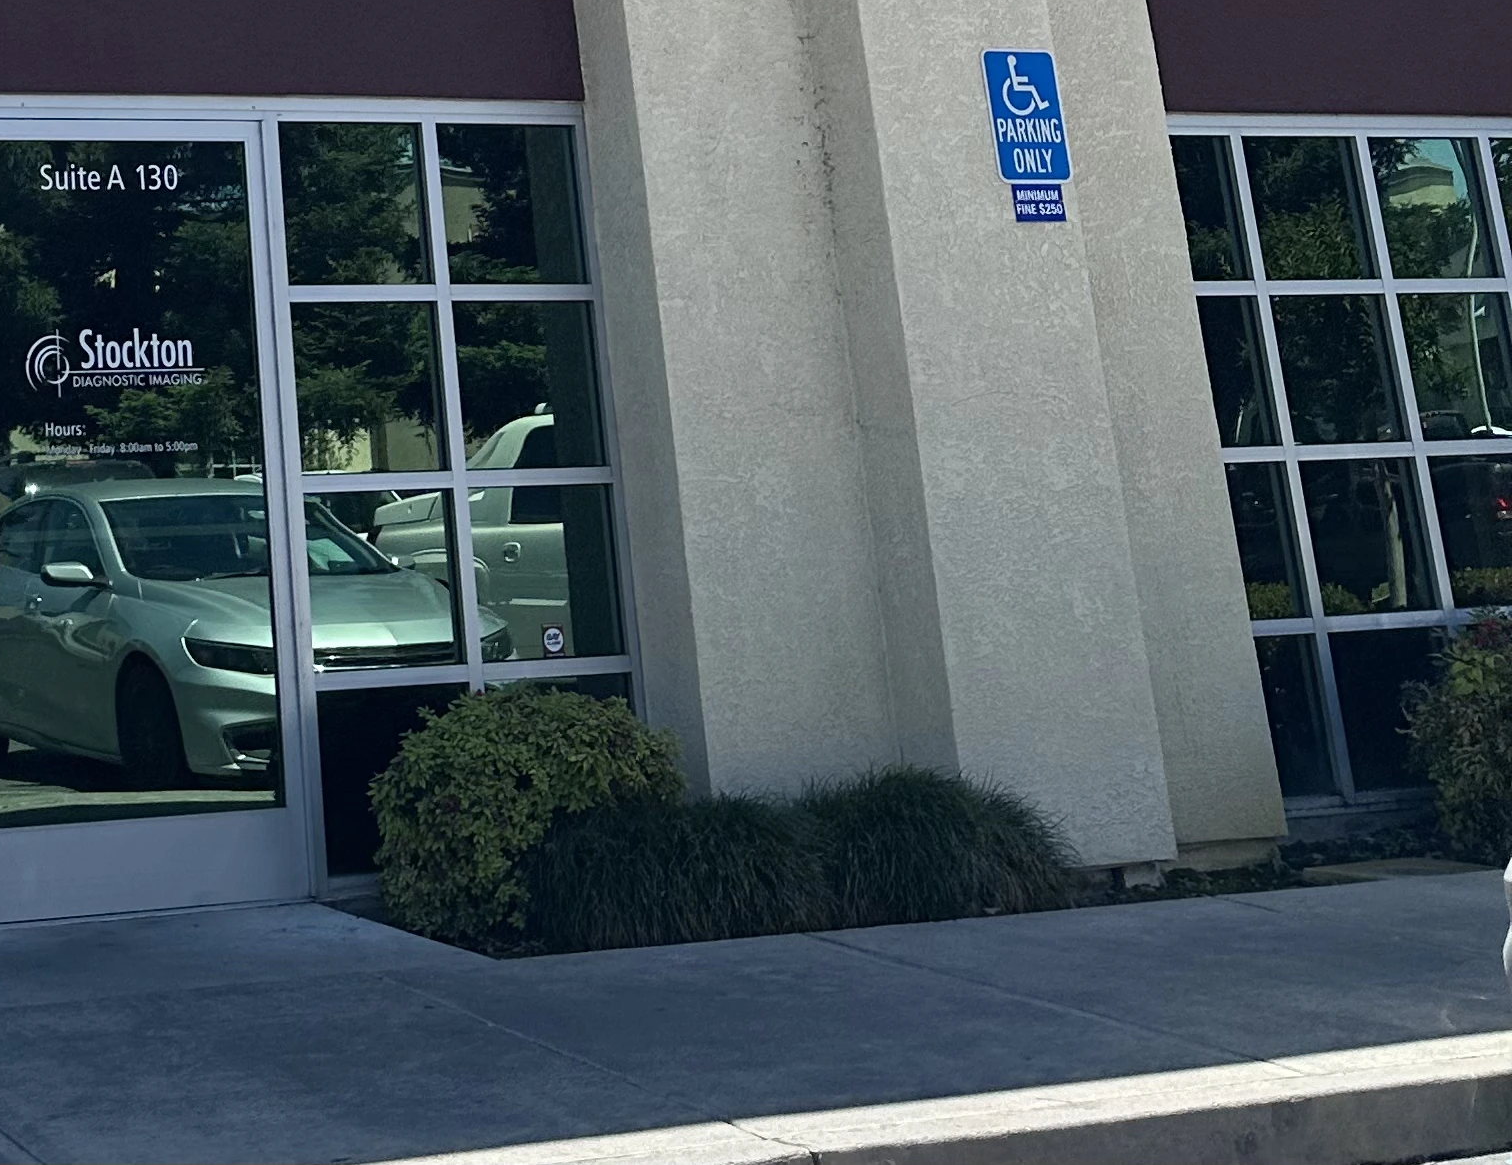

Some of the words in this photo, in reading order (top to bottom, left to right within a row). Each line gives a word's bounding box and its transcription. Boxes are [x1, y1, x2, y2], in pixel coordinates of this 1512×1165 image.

[996, 118, 1062, 143] PARKING
[1013, 148, 1052, 173] ONLY
[40, 164, 101, 190] Suite
[107, 165, 125, 190] A
[136, 164, 178, 190] 130
[1016, 189, 1059, 201] MINIMUM
[1016, 203, 1037, 215] FINE
[1039, 203, 1063, 215] $250
[79, 328, 193, 369] Stockton
[72, 374, 145, 387] DIAGNOSTIC
[149, 373, 202, 385] IMAGING
[44, 422, 86, 437] Hours:
[120, 442, 152, 453] 8:00am
[154, 443, 164, 452] to
[165, 441, 198, 453] 5:00pm
